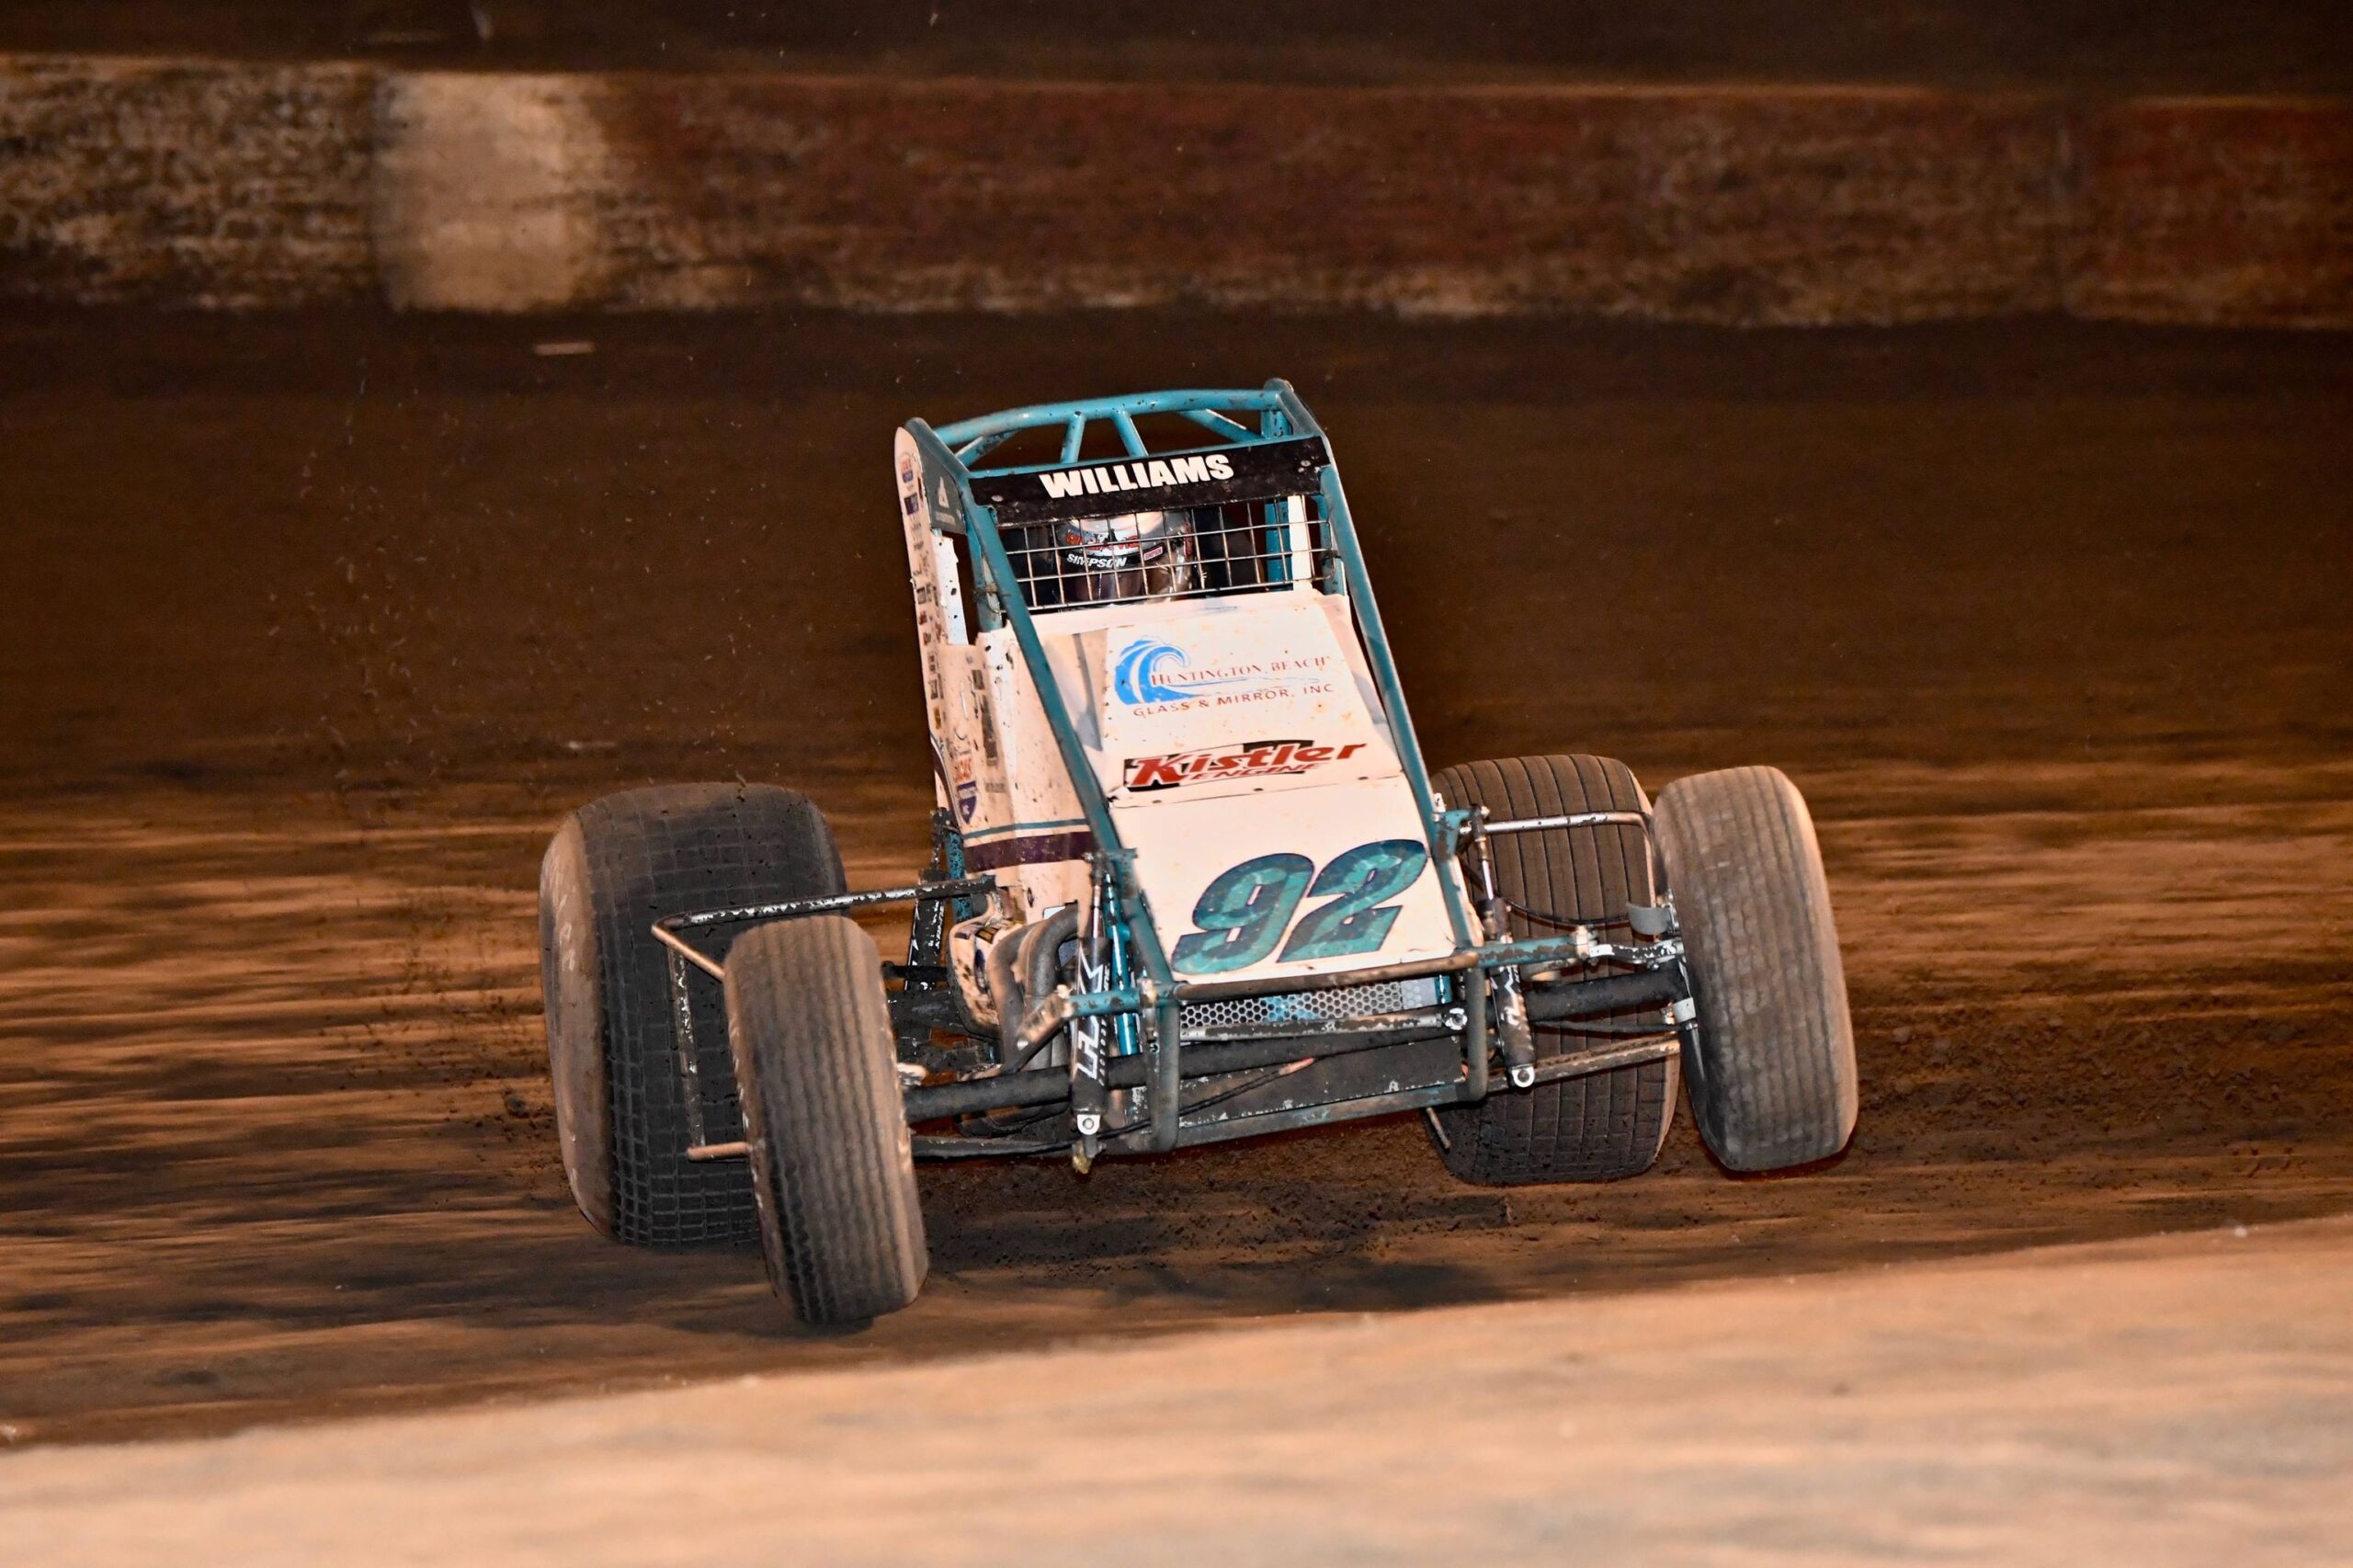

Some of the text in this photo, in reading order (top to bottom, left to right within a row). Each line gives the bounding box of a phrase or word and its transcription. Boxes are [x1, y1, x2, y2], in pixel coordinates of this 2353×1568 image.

[1039, 454, 1234, 498] WILLIAMS
[1066, 553, 1128, 568] SIMPSON
[1151, 656, 1332, 686] HUNTINGTON BEACH
[1132, 698, 1190, 719] GLASS
[1199, 699, 1210, 708] &
[1303, 684, 1334, 695] INC
[1131, 744, 1368, 786] Kistler
[1170, 839, 1427, 975] 92
